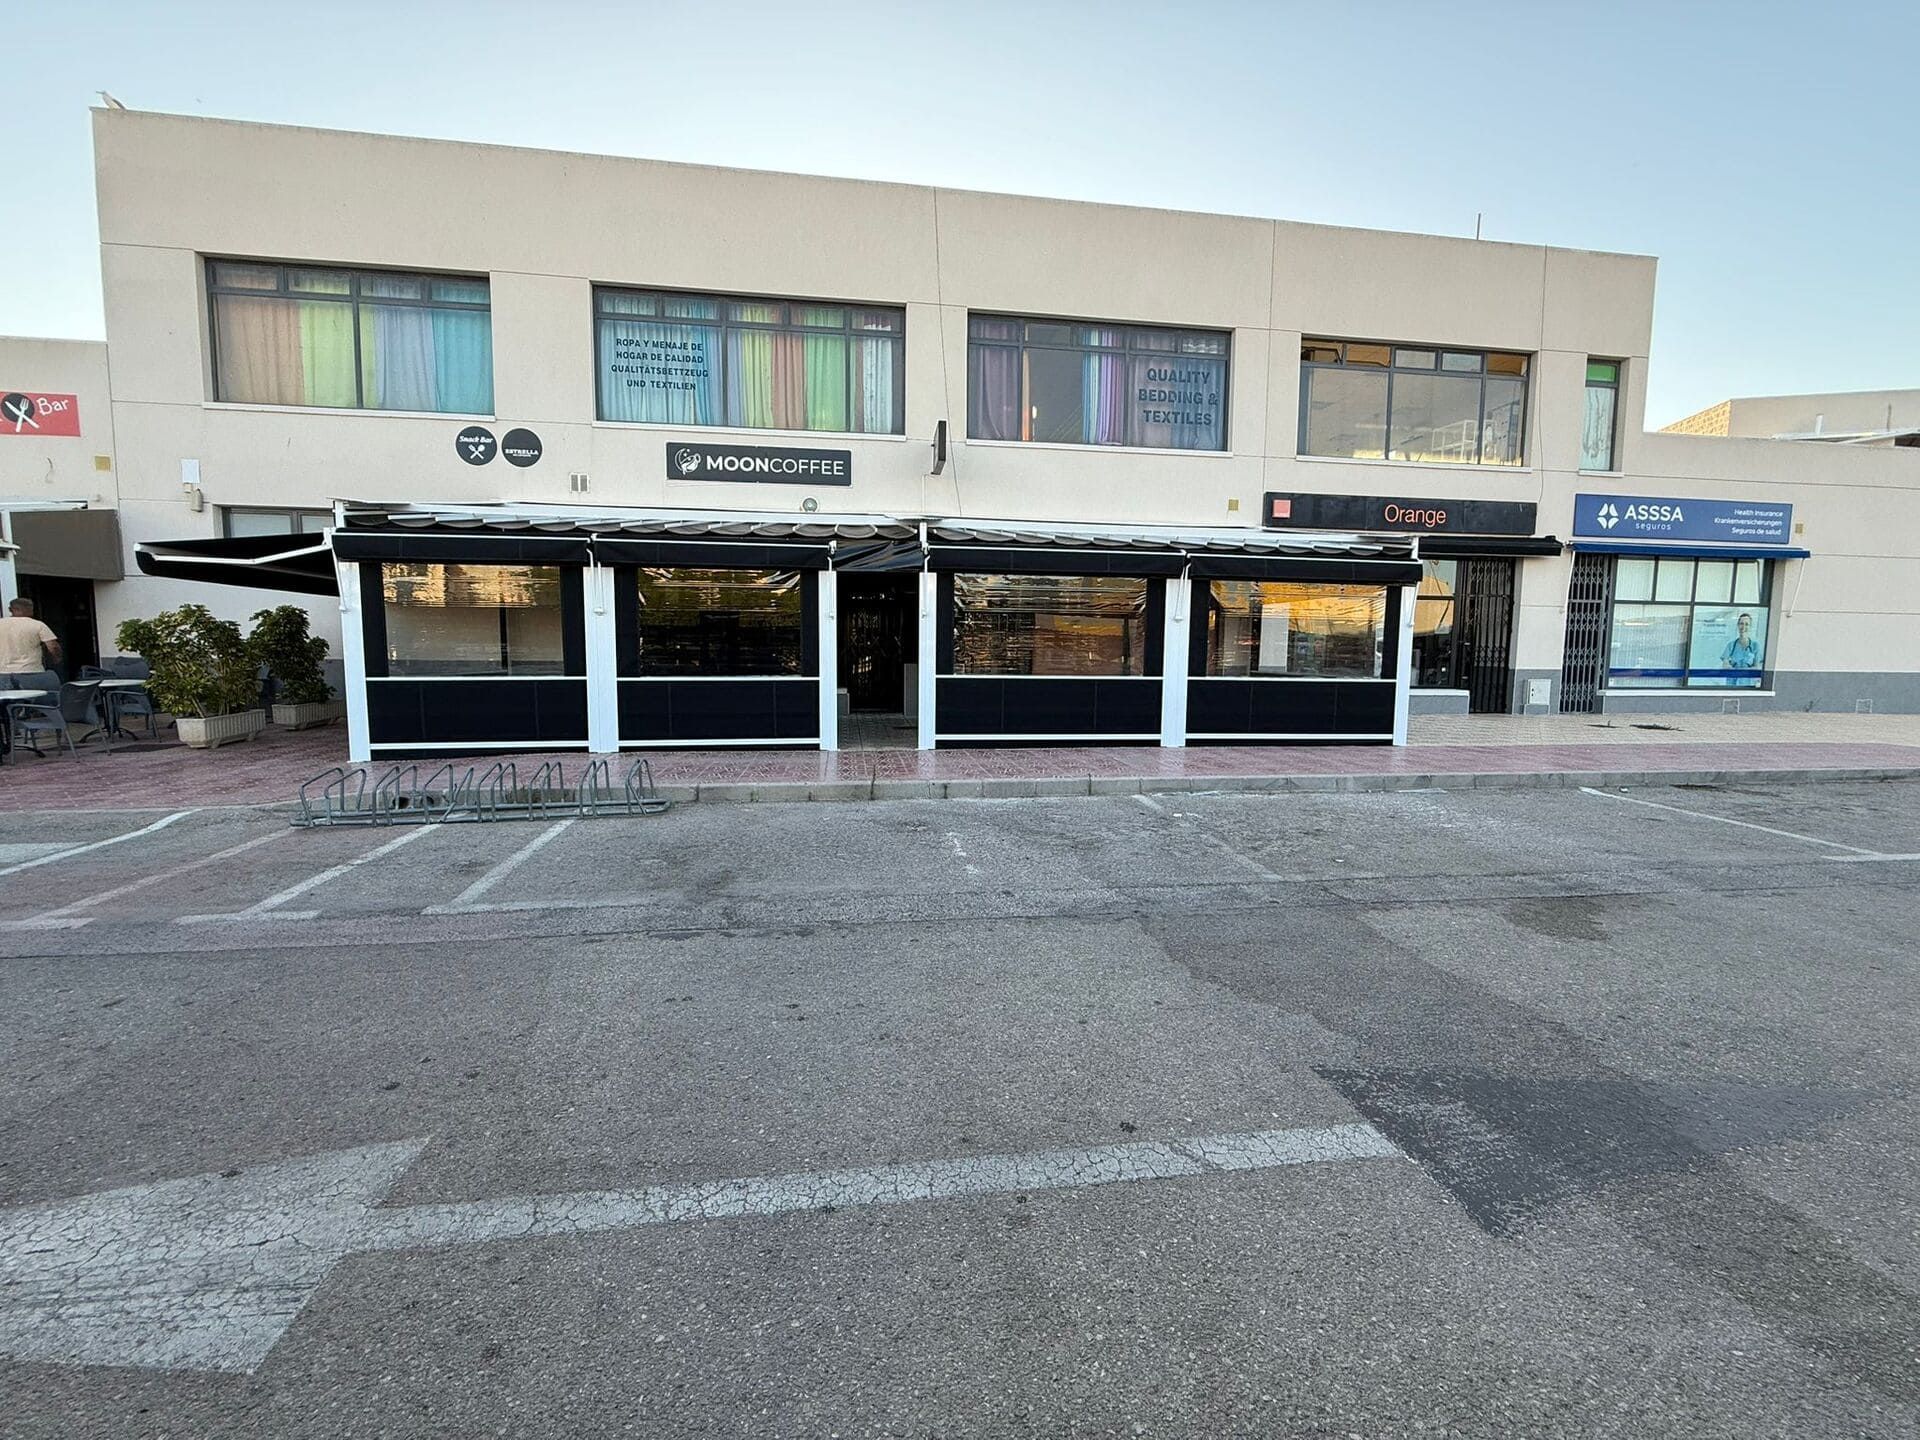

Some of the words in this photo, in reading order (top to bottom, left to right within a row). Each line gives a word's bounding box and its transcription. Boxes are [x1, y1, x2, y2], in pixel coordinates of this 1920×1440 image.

[616, 338, 641, 347] ROPA
[652, 340, 689, 350] MENAJE
[691, 343, 704, 351] DE
[616, 351, 648, 361] HOGAR
[651, 353, 663, 361] DE
[664, 354, 704, 363] CALIDAD
[1147, 368, 1210, 385] QUALITY
[627, 380, 646, 388] UND
[650, 381, 696, 391] TEXTILIEN
[1138, 388, 1203, 405] BEDDING
[1207, 393, 1218, 406] &
[36, 397, 69, 416] Bar
[1143, 409, 1212, 426] TEXTILES
[706, 455, 845, 476] MOONCOFFEE
[1384, 504, 1447, 527] Orange
[1623, 504, 1684, 522] ASSSA
[1635, 522, 1672, 531] seguros
[1731, 527, 1756, 535] Seguros
